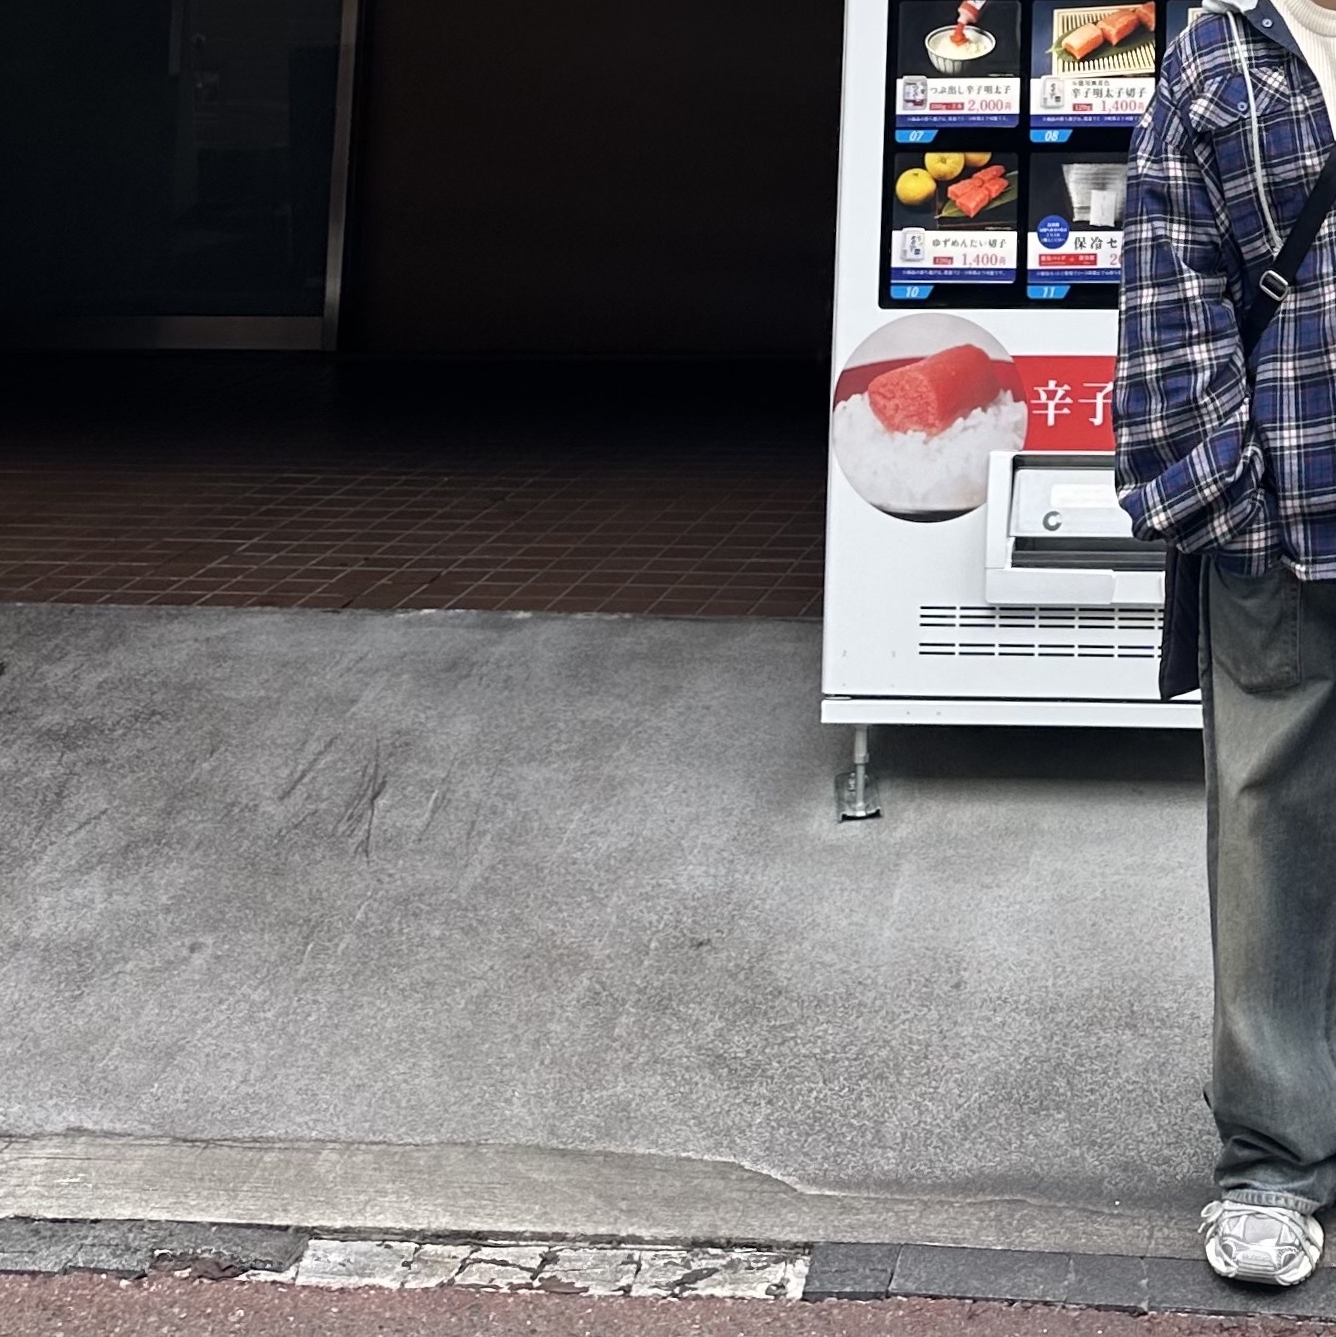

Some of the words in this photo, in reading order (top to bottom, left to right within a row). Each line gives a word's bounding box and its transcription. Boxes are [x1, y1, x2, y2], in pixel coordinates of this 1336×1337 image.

[909, 130, 924, 142] 07
[1044, 131, 1060, 141] 08
[906, 286, 919, 298] 10
[1043, 286, 1056, 298] 11
[1030, 379, 1114, 426] 辛子
